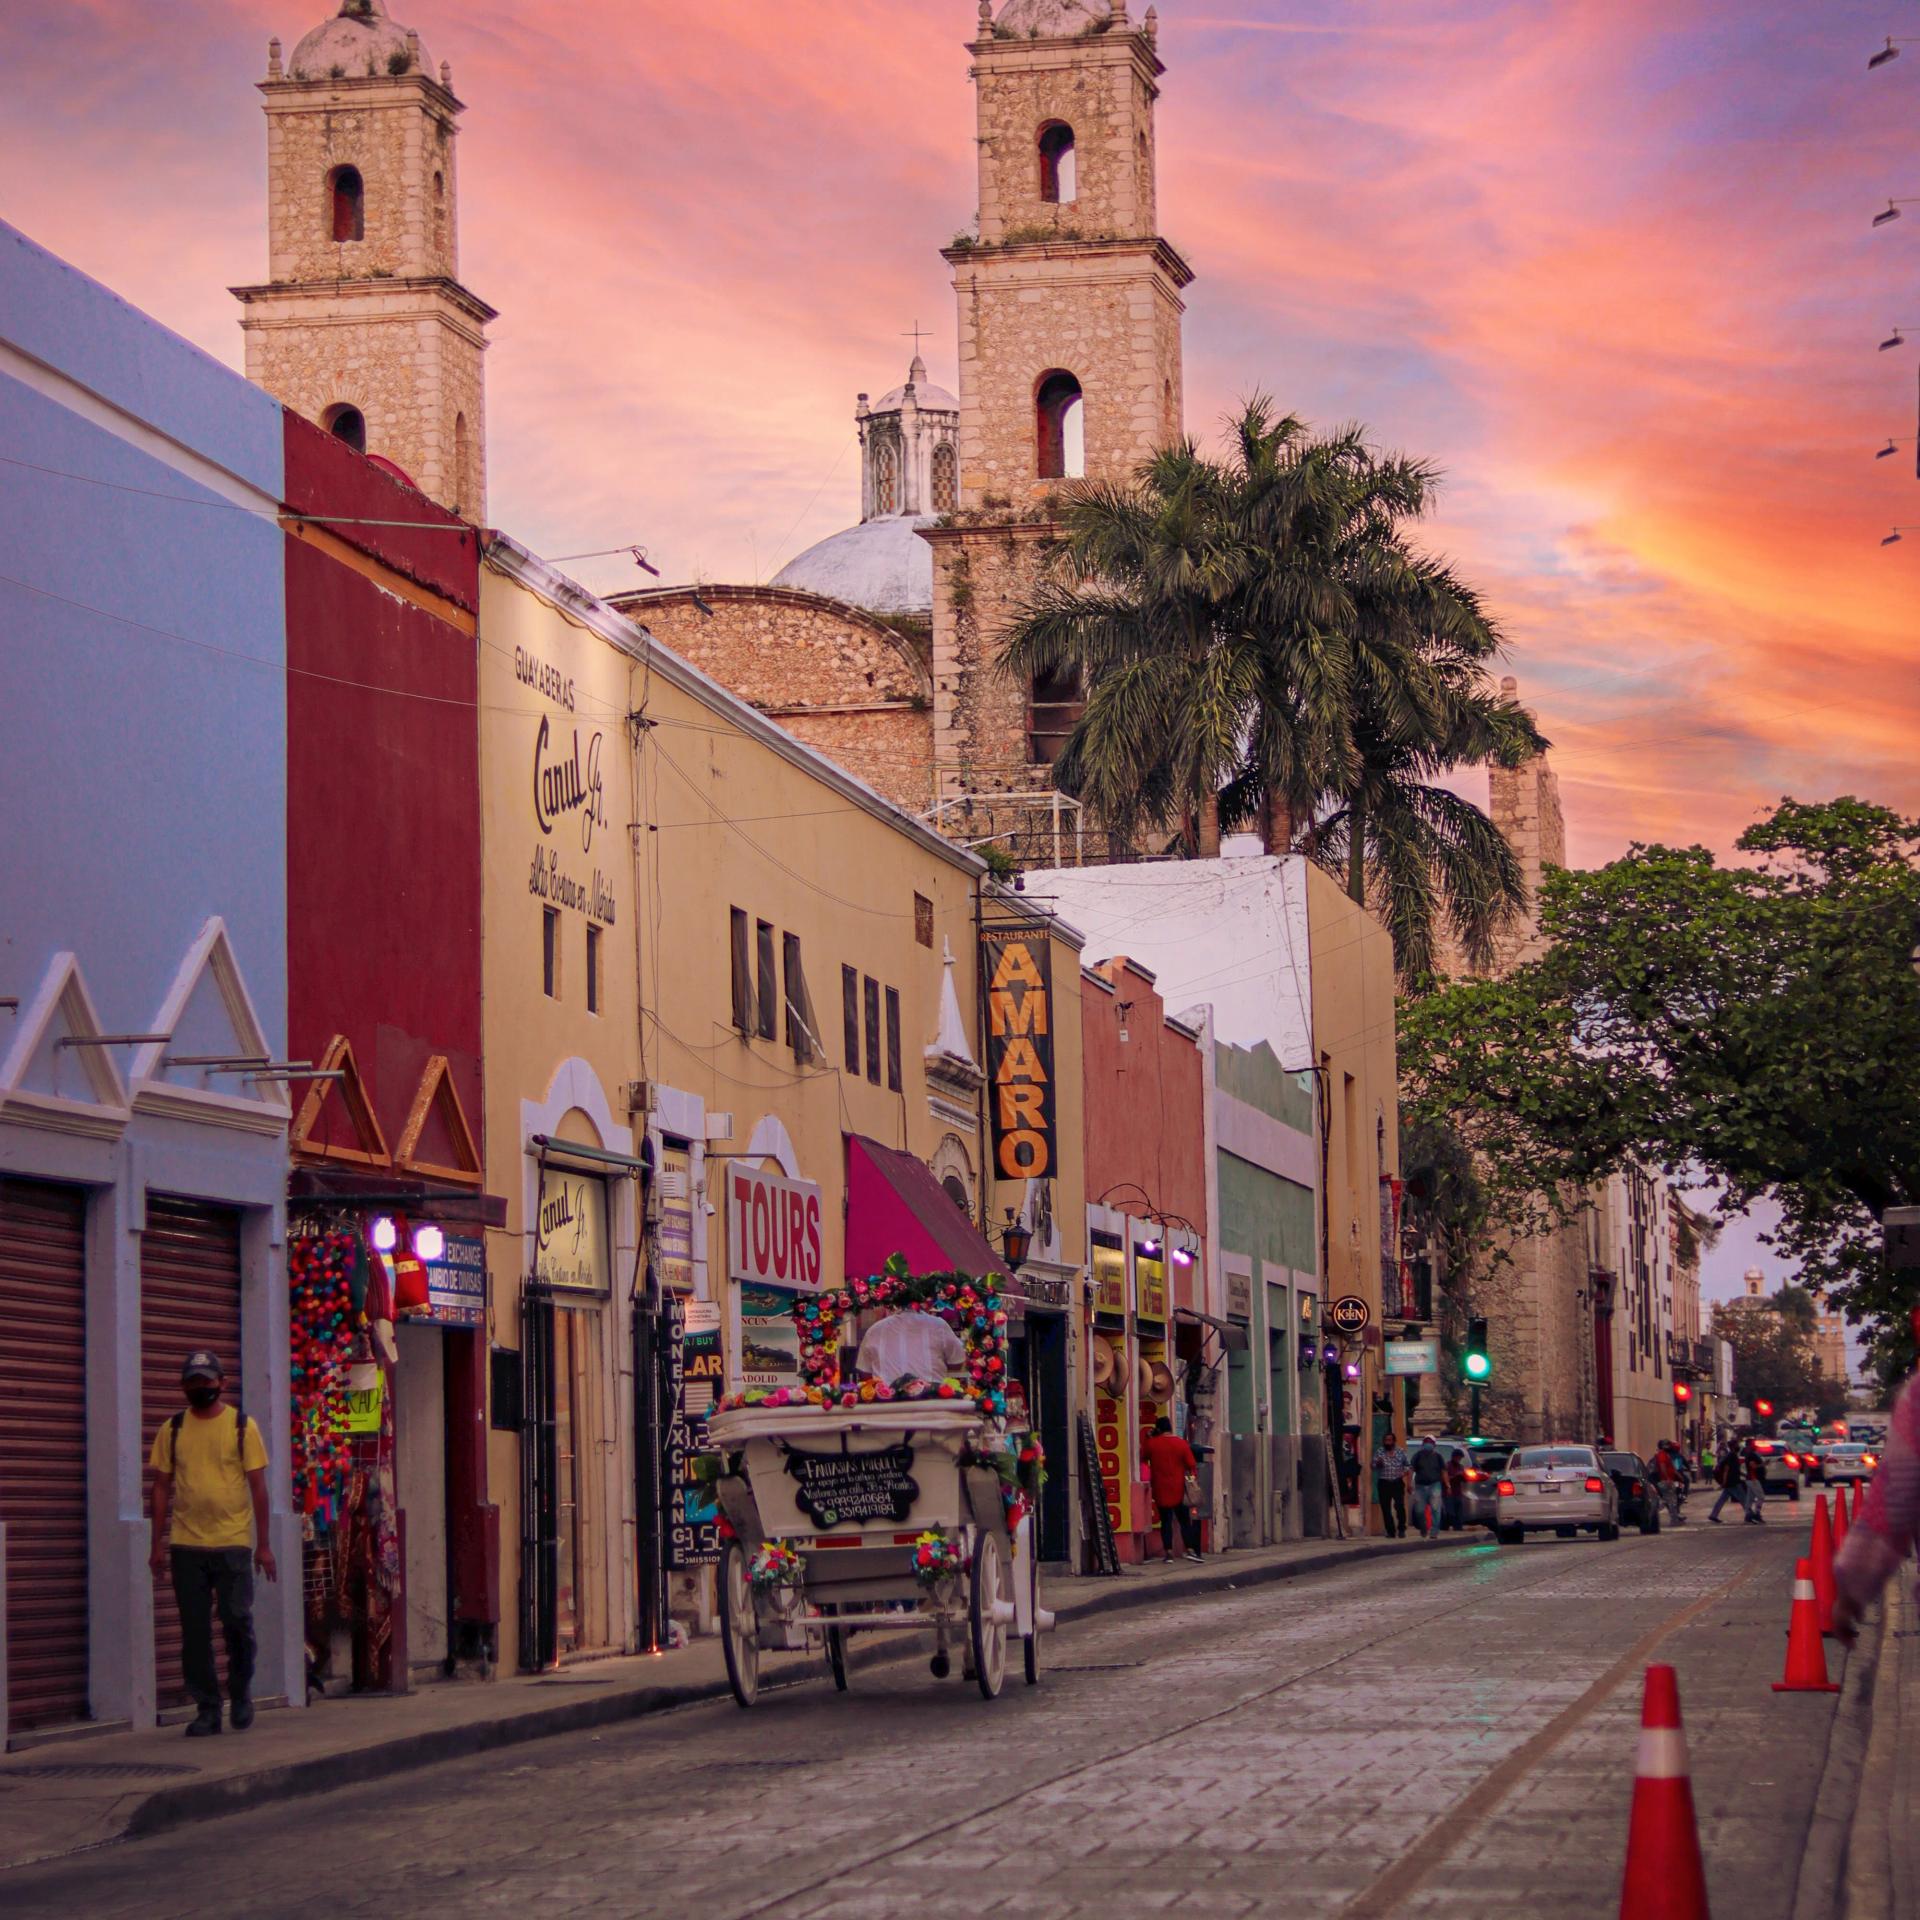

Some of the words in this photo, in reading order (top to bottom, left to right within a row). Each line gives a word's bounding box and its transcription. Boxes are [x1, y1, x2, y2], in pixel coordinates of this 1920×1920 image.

[515, 645, 575, 713] GUAYABERAS
[534, 713, 587, 834] Canul
[980, 930, 1050, 942] RESTAURANTE
[990, 943, 1049, 1178] AMARO
[447, 1243, 481, 1267] EXCHANGE
[735, 1176, 820, 1285] TOURS
[428, 1267, 448, 1289] AMBIO
[449, 1269, 458, 1290] DE
[458, 1271, 481, 1292] DIVISAS
[670, 1304, 684, 1402] MONEY
[684, 1355, 723, 1376] AR
[696, 1337, 714, 1346] BUY
[671, 1409, 685, 1564] EXCHANGE
